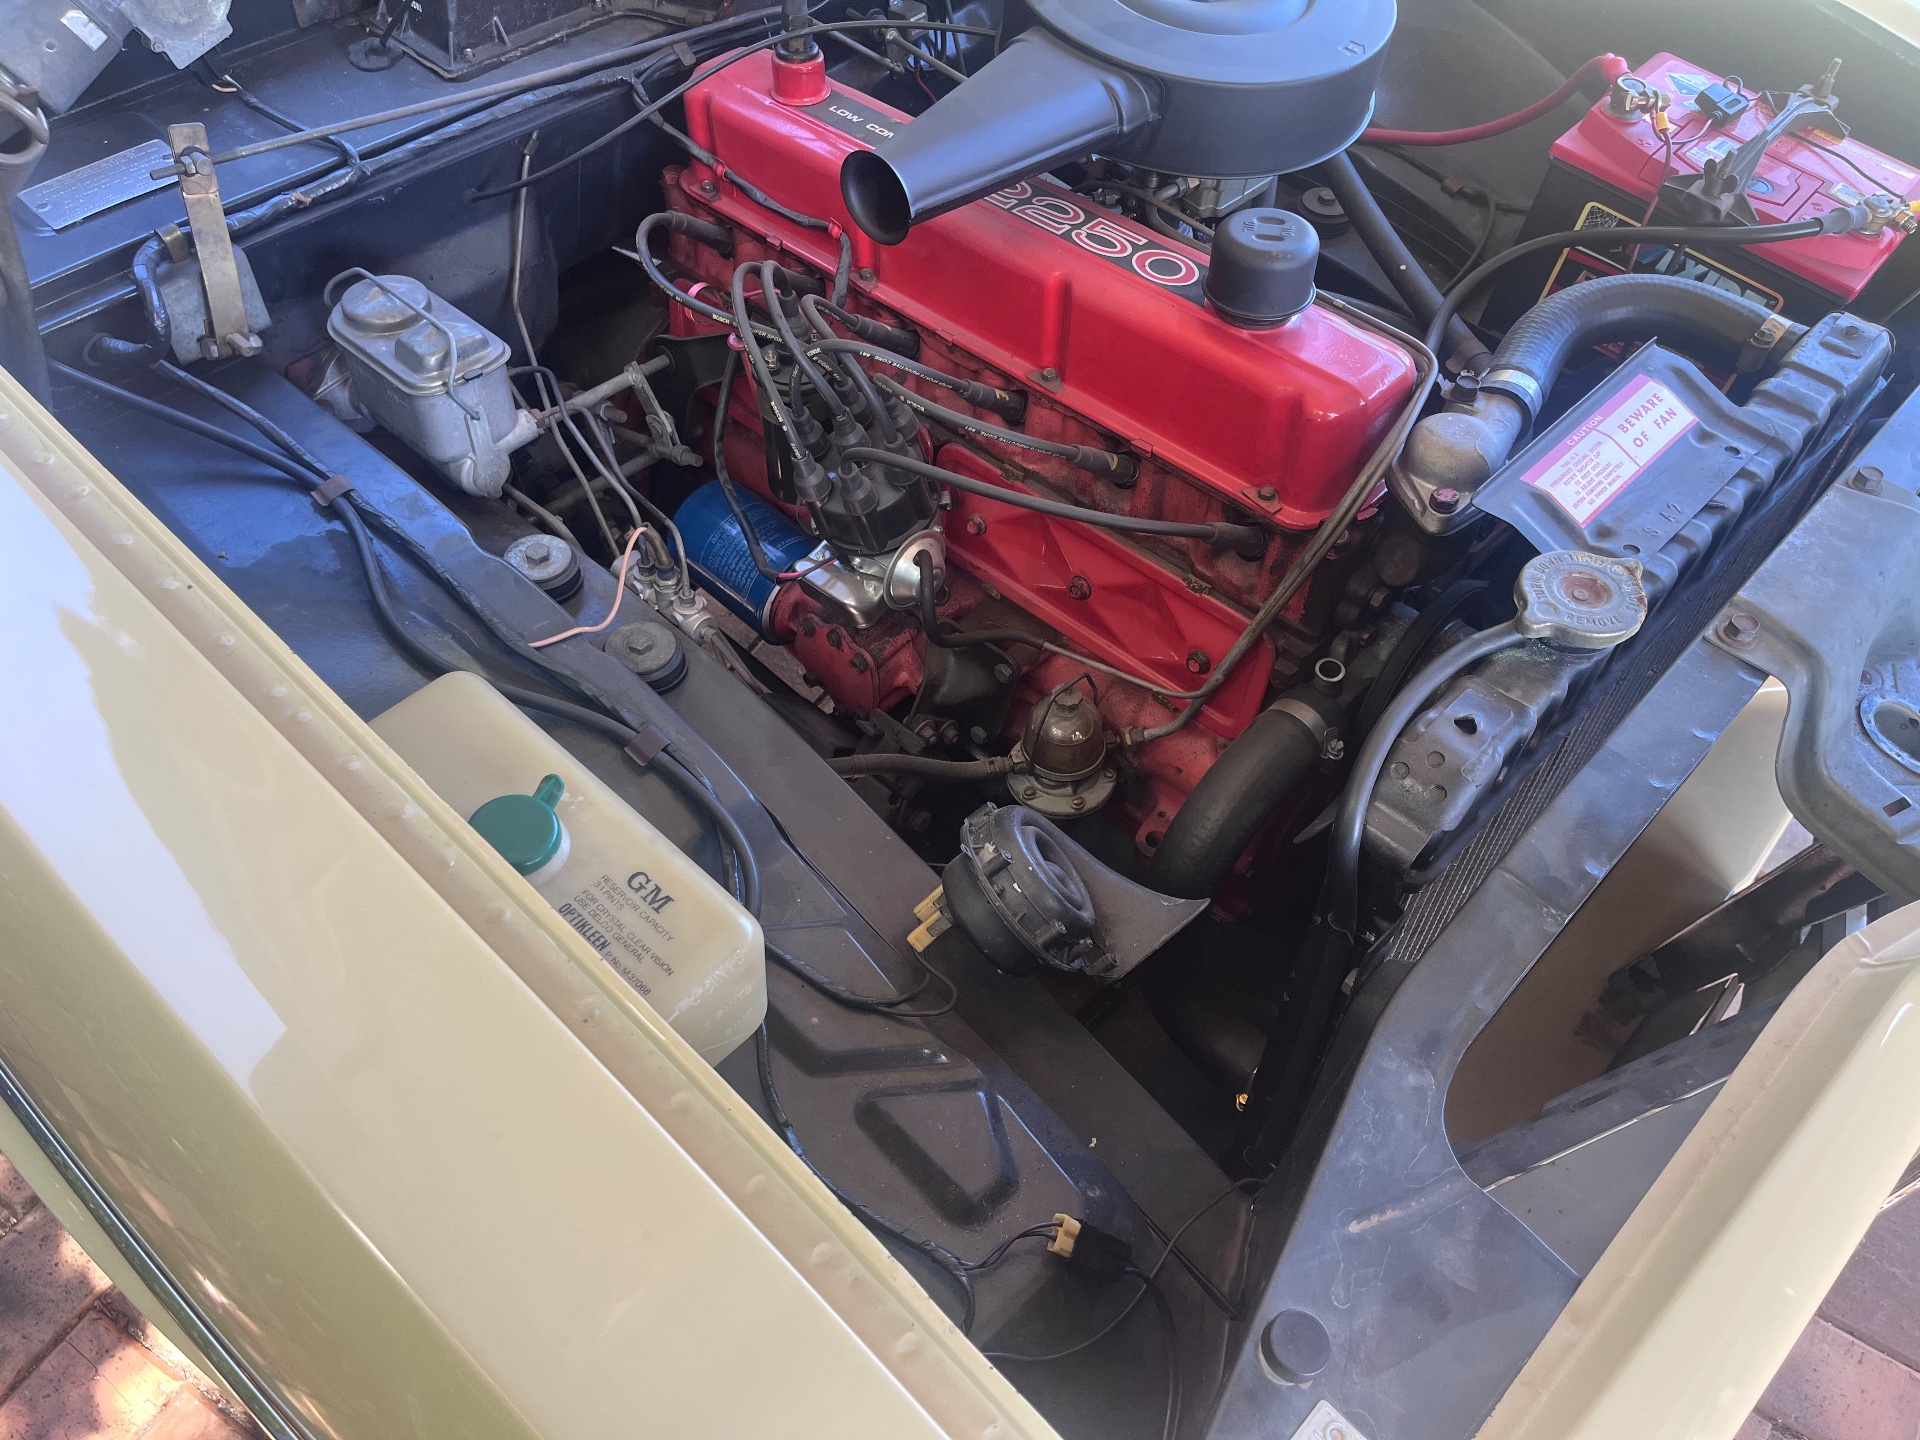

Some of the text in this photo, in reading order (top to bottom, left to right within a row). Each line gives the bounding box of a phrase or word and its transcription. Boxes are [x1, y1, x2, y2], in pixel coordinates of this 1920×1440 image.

[828, 105, 864, 123] LOW
[984, 181, 1200, 286] 2250
[712, 313, 730, 325] BOSCH
[770, 400, 784, 423] BOSCH
[1616, 392, 1664, 434] BEWARE
[1632, 407, 1678, 448] OF FAN
[1566, 414, 1604, 447] CAUTION
[1563, 451, 1602, 487] ROTATE RADIATOR CAP
[1580, 470, 1592, 481] FIRST
[1590, 461, 1601, 472] STOP
[1572, 495, 1587, 510] BEFORE
[1585, 479, 1605, 497] REMOVING
[1586, 497, 1596, 506] SEE
[1594, 485, 1609, 499] OWNER
[1535, 555, 1563, 575] DOWN
[1566, 613, 1624, 628] REMOVE
[601, 874, 675, 942] RESERVOIR CAPACITY
[602, 887, 625, 911] PINTS
[627, 871, 675, 914] GM
[558, 902, 612, 952] OPTIKLEEN
[573, 894, 644, 964] USE DELCO GENERAL
[581, 889, 675, 976] FOR CRYSTAL CLEAR VISION
